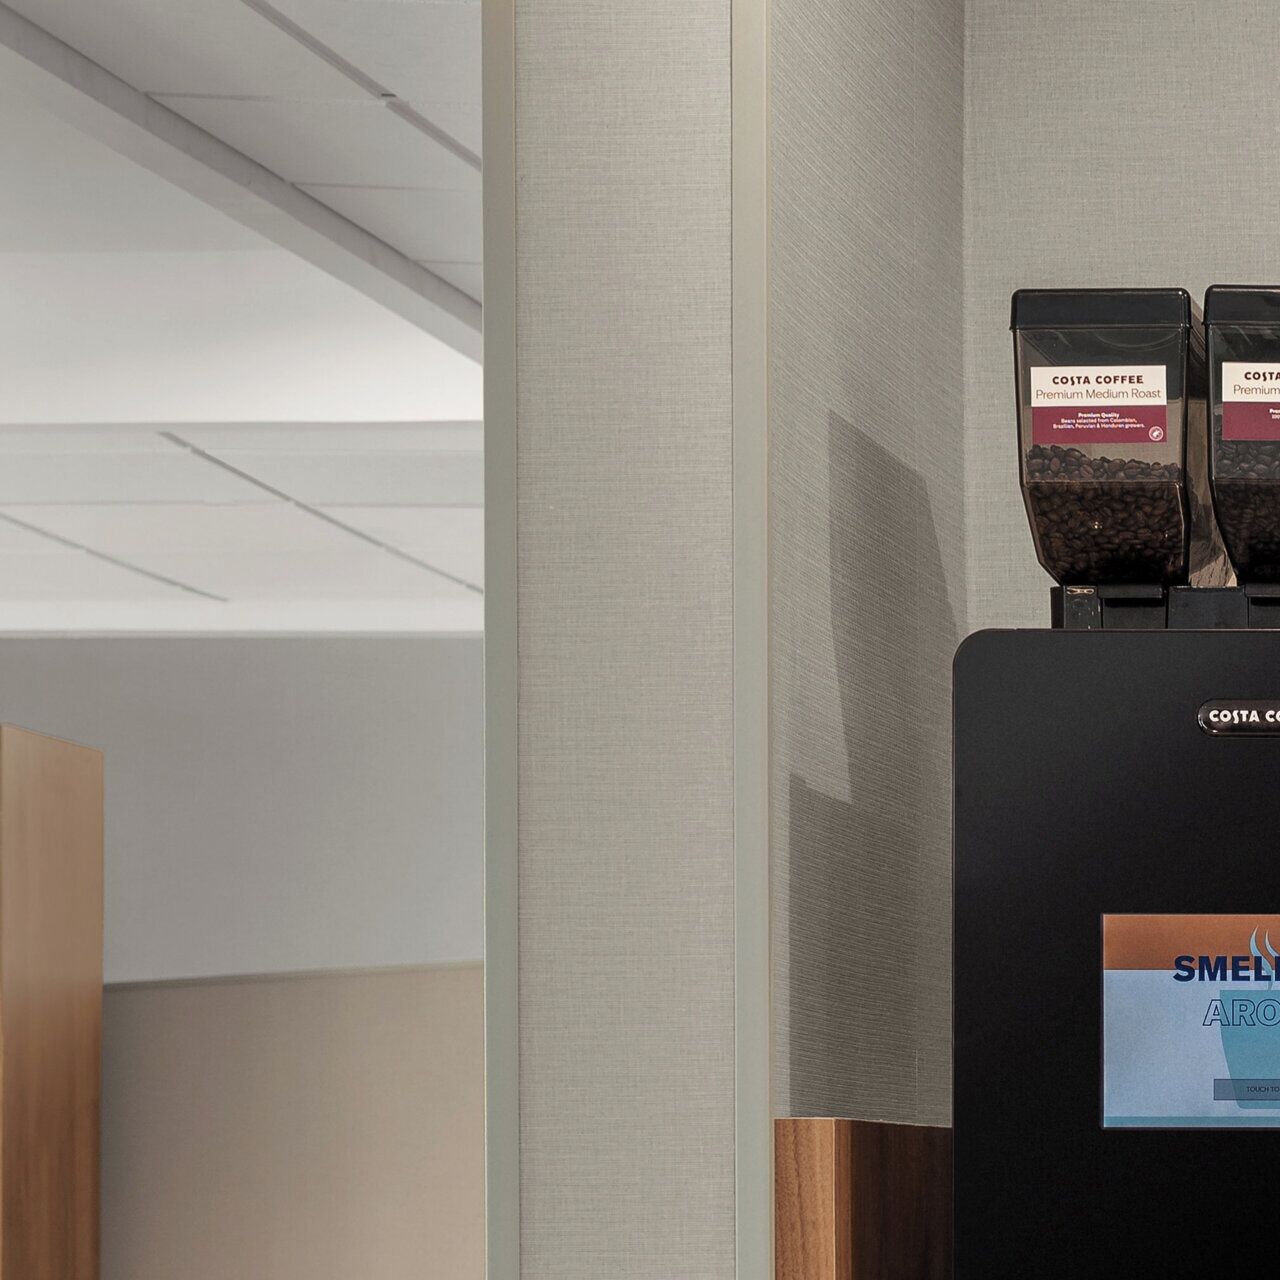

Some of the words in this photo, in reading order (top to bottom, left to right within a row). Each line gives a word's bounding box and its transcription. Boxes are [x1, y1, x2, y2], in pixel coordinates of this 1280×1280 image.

[1052, 376, 1091, 386] COSTA
[1096, 375, 1144, 384] COFFEE
[1036, 389, 1083, 400] Premium
[1086, 389, 1129, 399] Medium
[1131, 388, 1161, 399] Roast
[1233, 385, 1280, 395] Premium
[1209, 710, 1260, 724] COSTA
